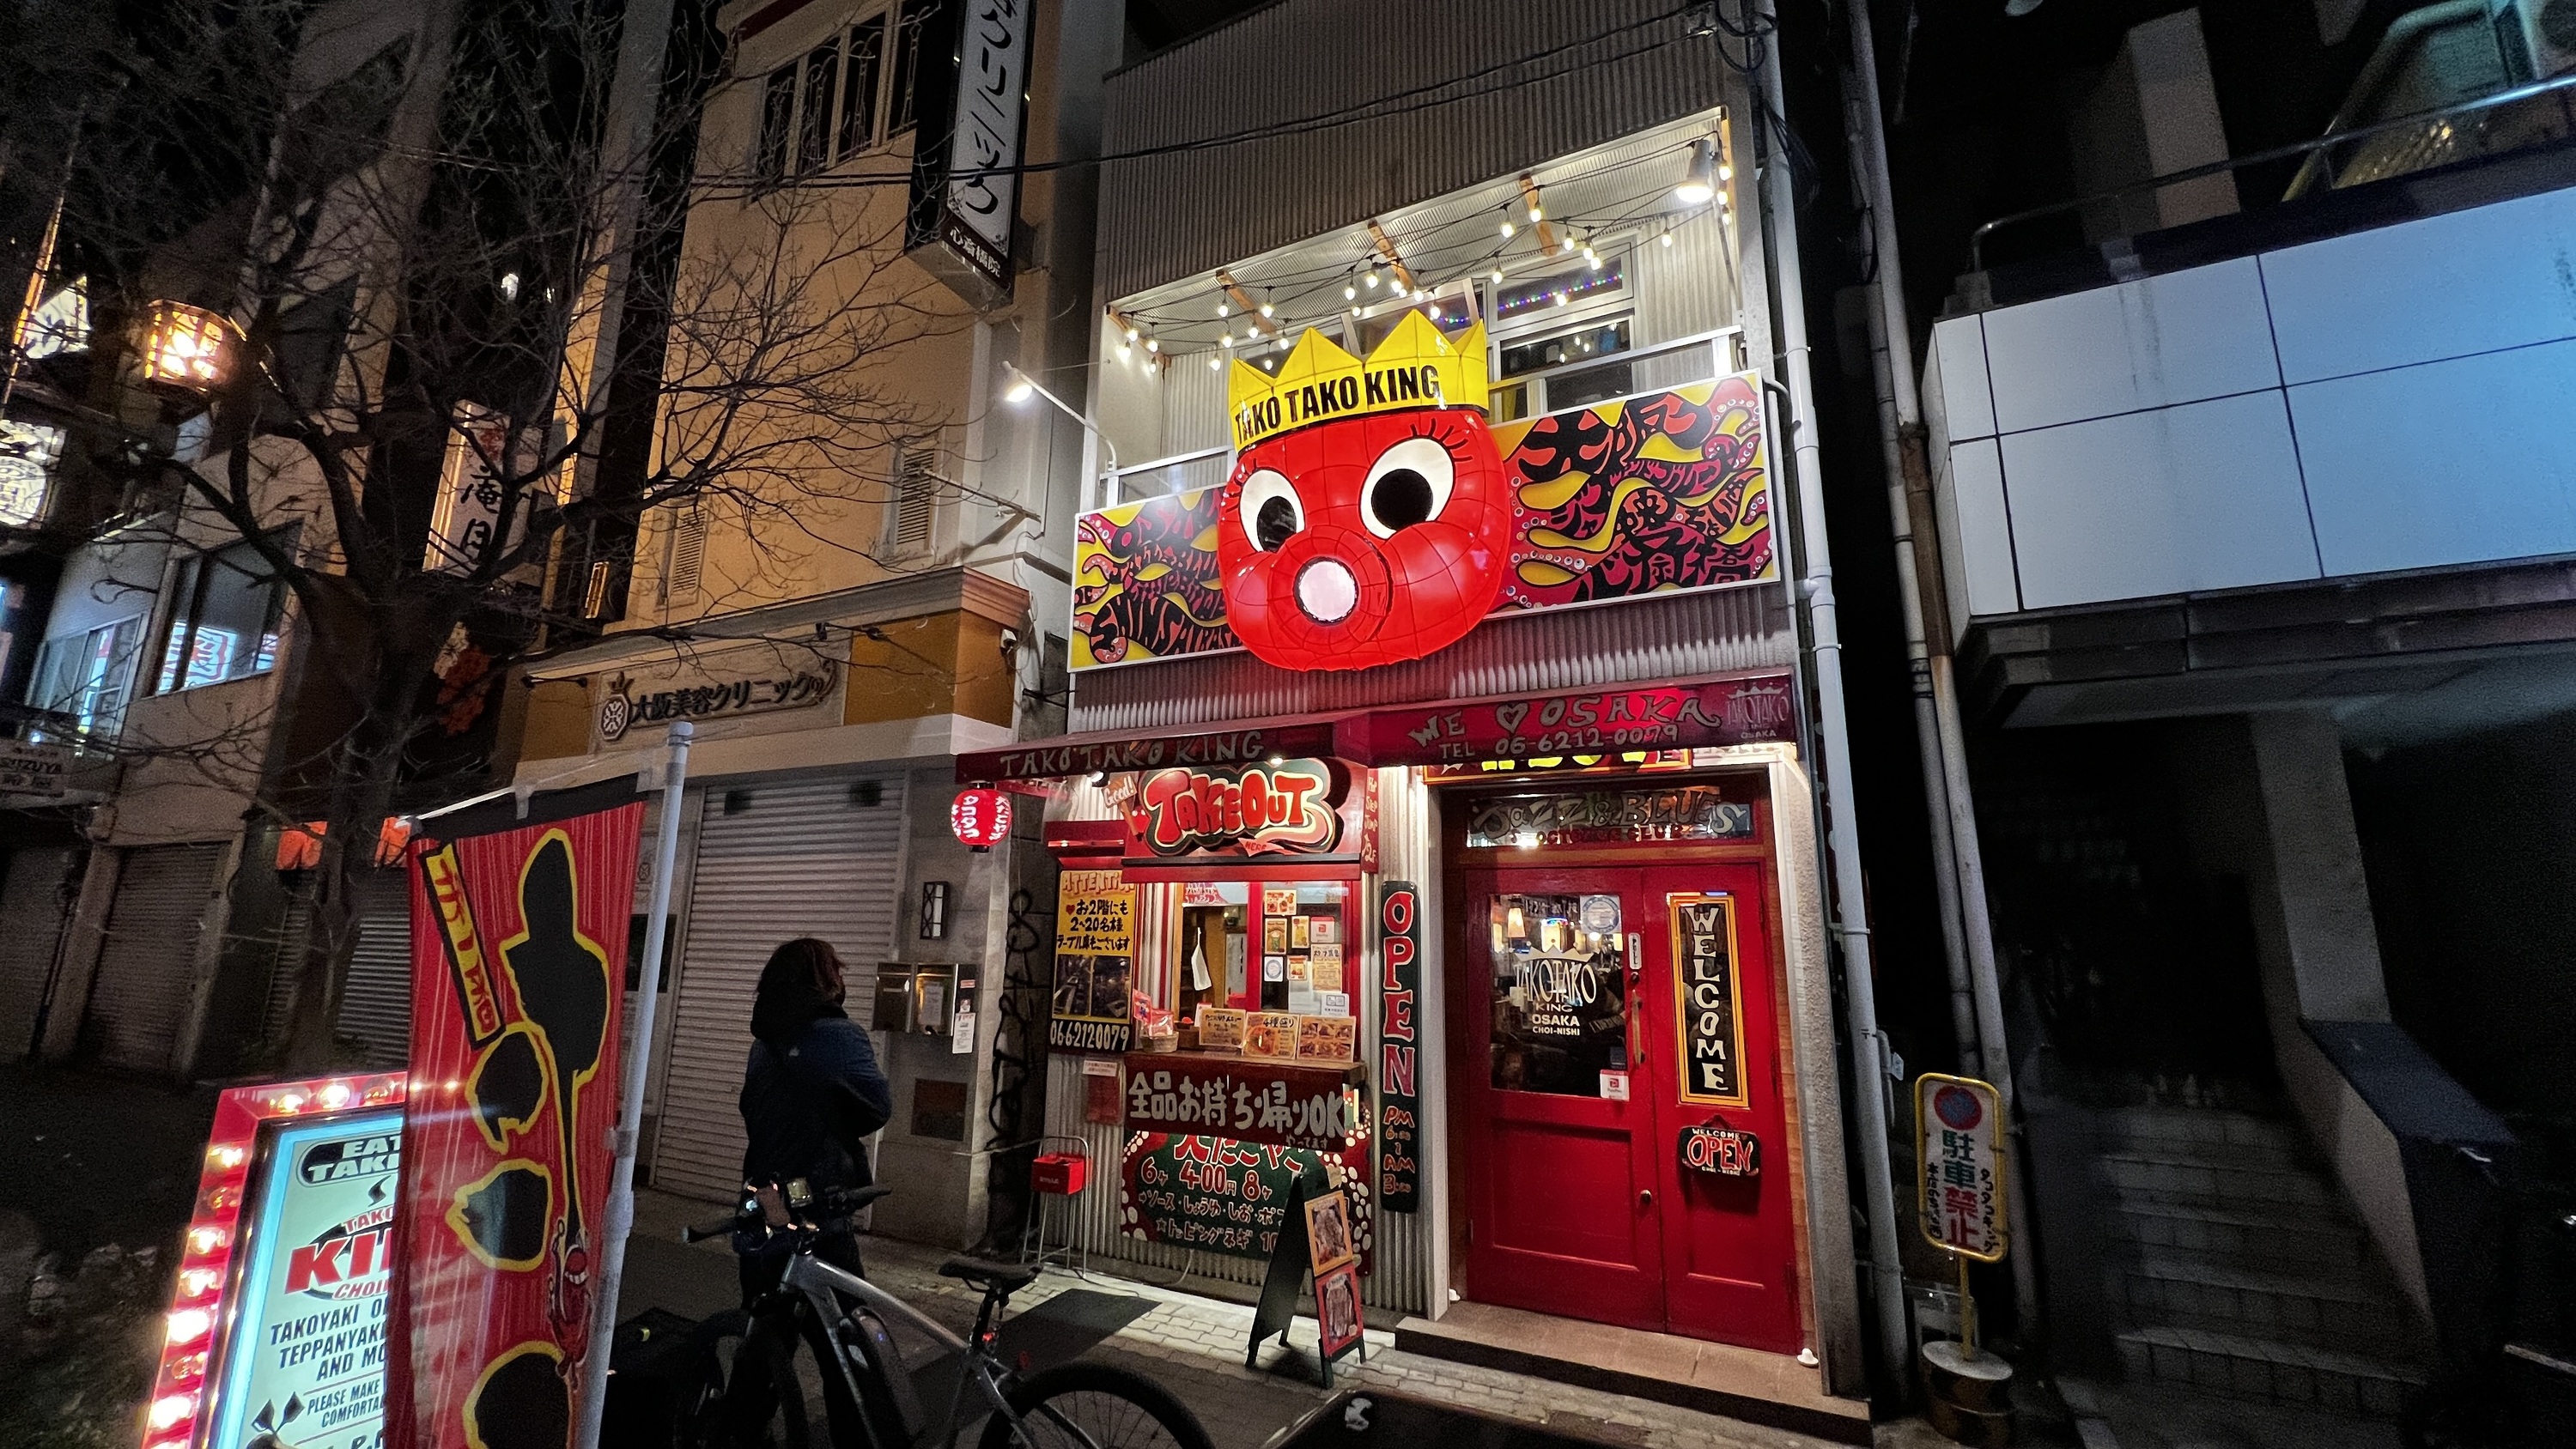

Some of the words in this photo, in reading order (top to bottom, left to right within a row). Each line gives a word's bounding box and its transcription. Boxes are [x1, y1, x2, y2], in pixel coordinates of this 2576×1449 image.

[1235, 396, 1282, 445] TAKO
[1285, 375, 1359, 422] TAKO
[1364, 364, 1441, 399] KING
[631, 676, 810, 723] 大阪美容クリニック
[1406, 712, 1466, 749] WE
[1539, 694, 1722, 729] OSAKA
[999, 746, 1071, 777] TAKO
[1079, 739, 1164, 771] TAKO
[1174, 730, 1265, 765] KING
[1439, 741, 1475, 760] TEL
[1495, 723, 1679, 755] 06-6212-0079
[961, 794, 981, 839] タコタコ
[1382, 890, 1416, 1097] OPEN
[1535, 1003, 1573, 1012] KING
[1684, 906, 1729, 1091] WELCOME
[1532, 1014, 1580, 1027] OSAKA
[1532, 1026, 1581, 1036] CHOI-NISHI
[1382, 1105, 1415, 1129] PM
[1692, 1128, 1741, 1140] WELCOME
[1383, 1154, 1415, 1173] AM
[1687, 1134, 1753, 1173] OPEN
[1942, 1129, 1980, 1252] 駐車禁止
[270, 1303, 360, 1346] TAKOYAKI
[316, 1352, 354, 1381] AND
[307, 1389, 347, 1416] PLEASE
[349, 1379, 380, 1402] MAKE
